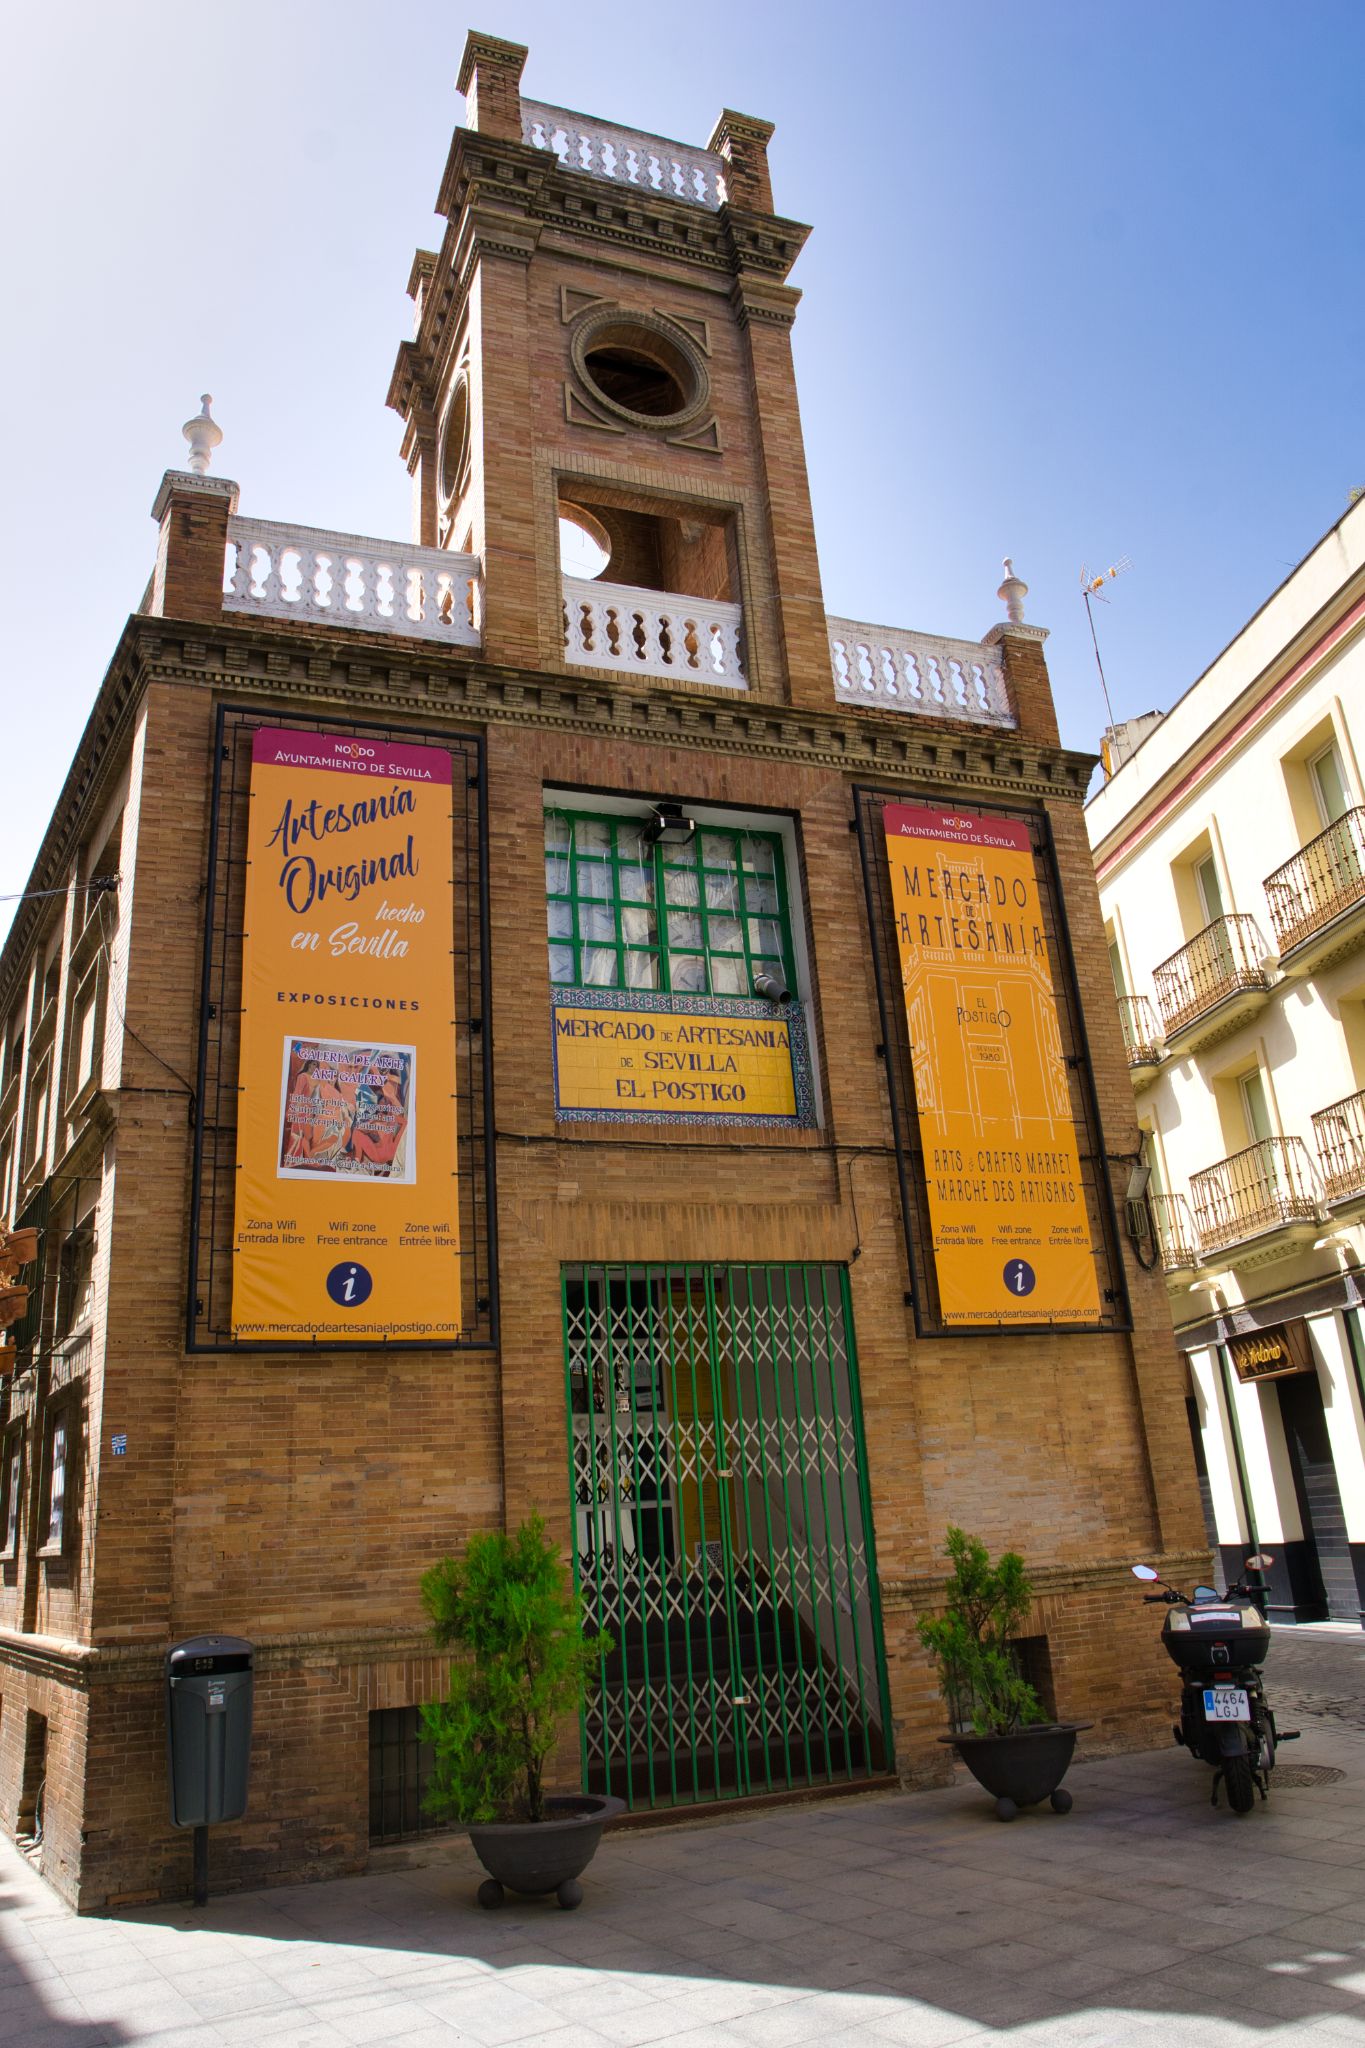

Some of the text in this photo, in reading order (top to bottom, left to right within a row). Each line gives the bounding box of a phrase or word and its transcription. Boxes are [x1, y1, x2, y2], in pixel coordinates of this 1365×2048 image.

[275, 750, 432, 779] AYUNTAMIENTO DE SEVILLA
[264, 785, 417, 856] Artesanía
[901, 823, 1016, 848] AYUNTAMIENTO DE SEVILLA
[279, 835, 419, 913] Original
[903, 865, 1027, 908] MERCADO
[376, 901, 425, 922] hecho
[965, 905, 974, 917] DE
[291, 922, 409, 959] en Sevilla
[277, 991, 420, 1011] EXPOSICIONES
[977, 998, 987, 1008] EL
[957, 1007, 1011, 1027] POSTIGO
[556, 1018, 790, 1049] MERCADO DE ARTESANIA
[354, 1055, 371, 1067] DE
[375, 1056, 405, 1070] ARTE
[620, 1052, 738, 1073] DE SEVILLA
[311, 1069, 388, 1087] ART GALERY
[616, 1079, 746, 1102] EL POSTIGO
[934, 1149, 963, 1172] ARTS
[977, 1151, 1022, 1173] CRAFTS
[1026, 1152, 1071, 1174] MARKET
[937, 1179, 1076, 1203] MARCHE DES ARTISANS
[247, 1220, 297, 1230] Zona Wifi
[329, 1221, 376, 1232] Wifi zone
[405, 1223, 450, 1232] Zone wifi
[940, 1224, 976, 1233] Zona Wifi
[998, 1225, 1032, 1234] Wifi zone
[238, 1233, 305, 1244] Entrada libre
[317, 1235, 388, 1246] Free entrance
[399, 1236, 456, 1246] Entrée libre
[935, 1236, 984, 1245] Entrada libre
[992, 1237, 1041, 1245] Free entrance
[1072, 1237, 1089, 1245] libre
[944, 1309, 1100, 1319] www.mercadodeartesaniaelpostigo.com
[235, 1321, 459, 1335] www.mercadodeartesaniaelpostigo.com
[1214, 1692, 1245, 1705] 4464
[1215, 1705, 1240, 1718] LGJ
